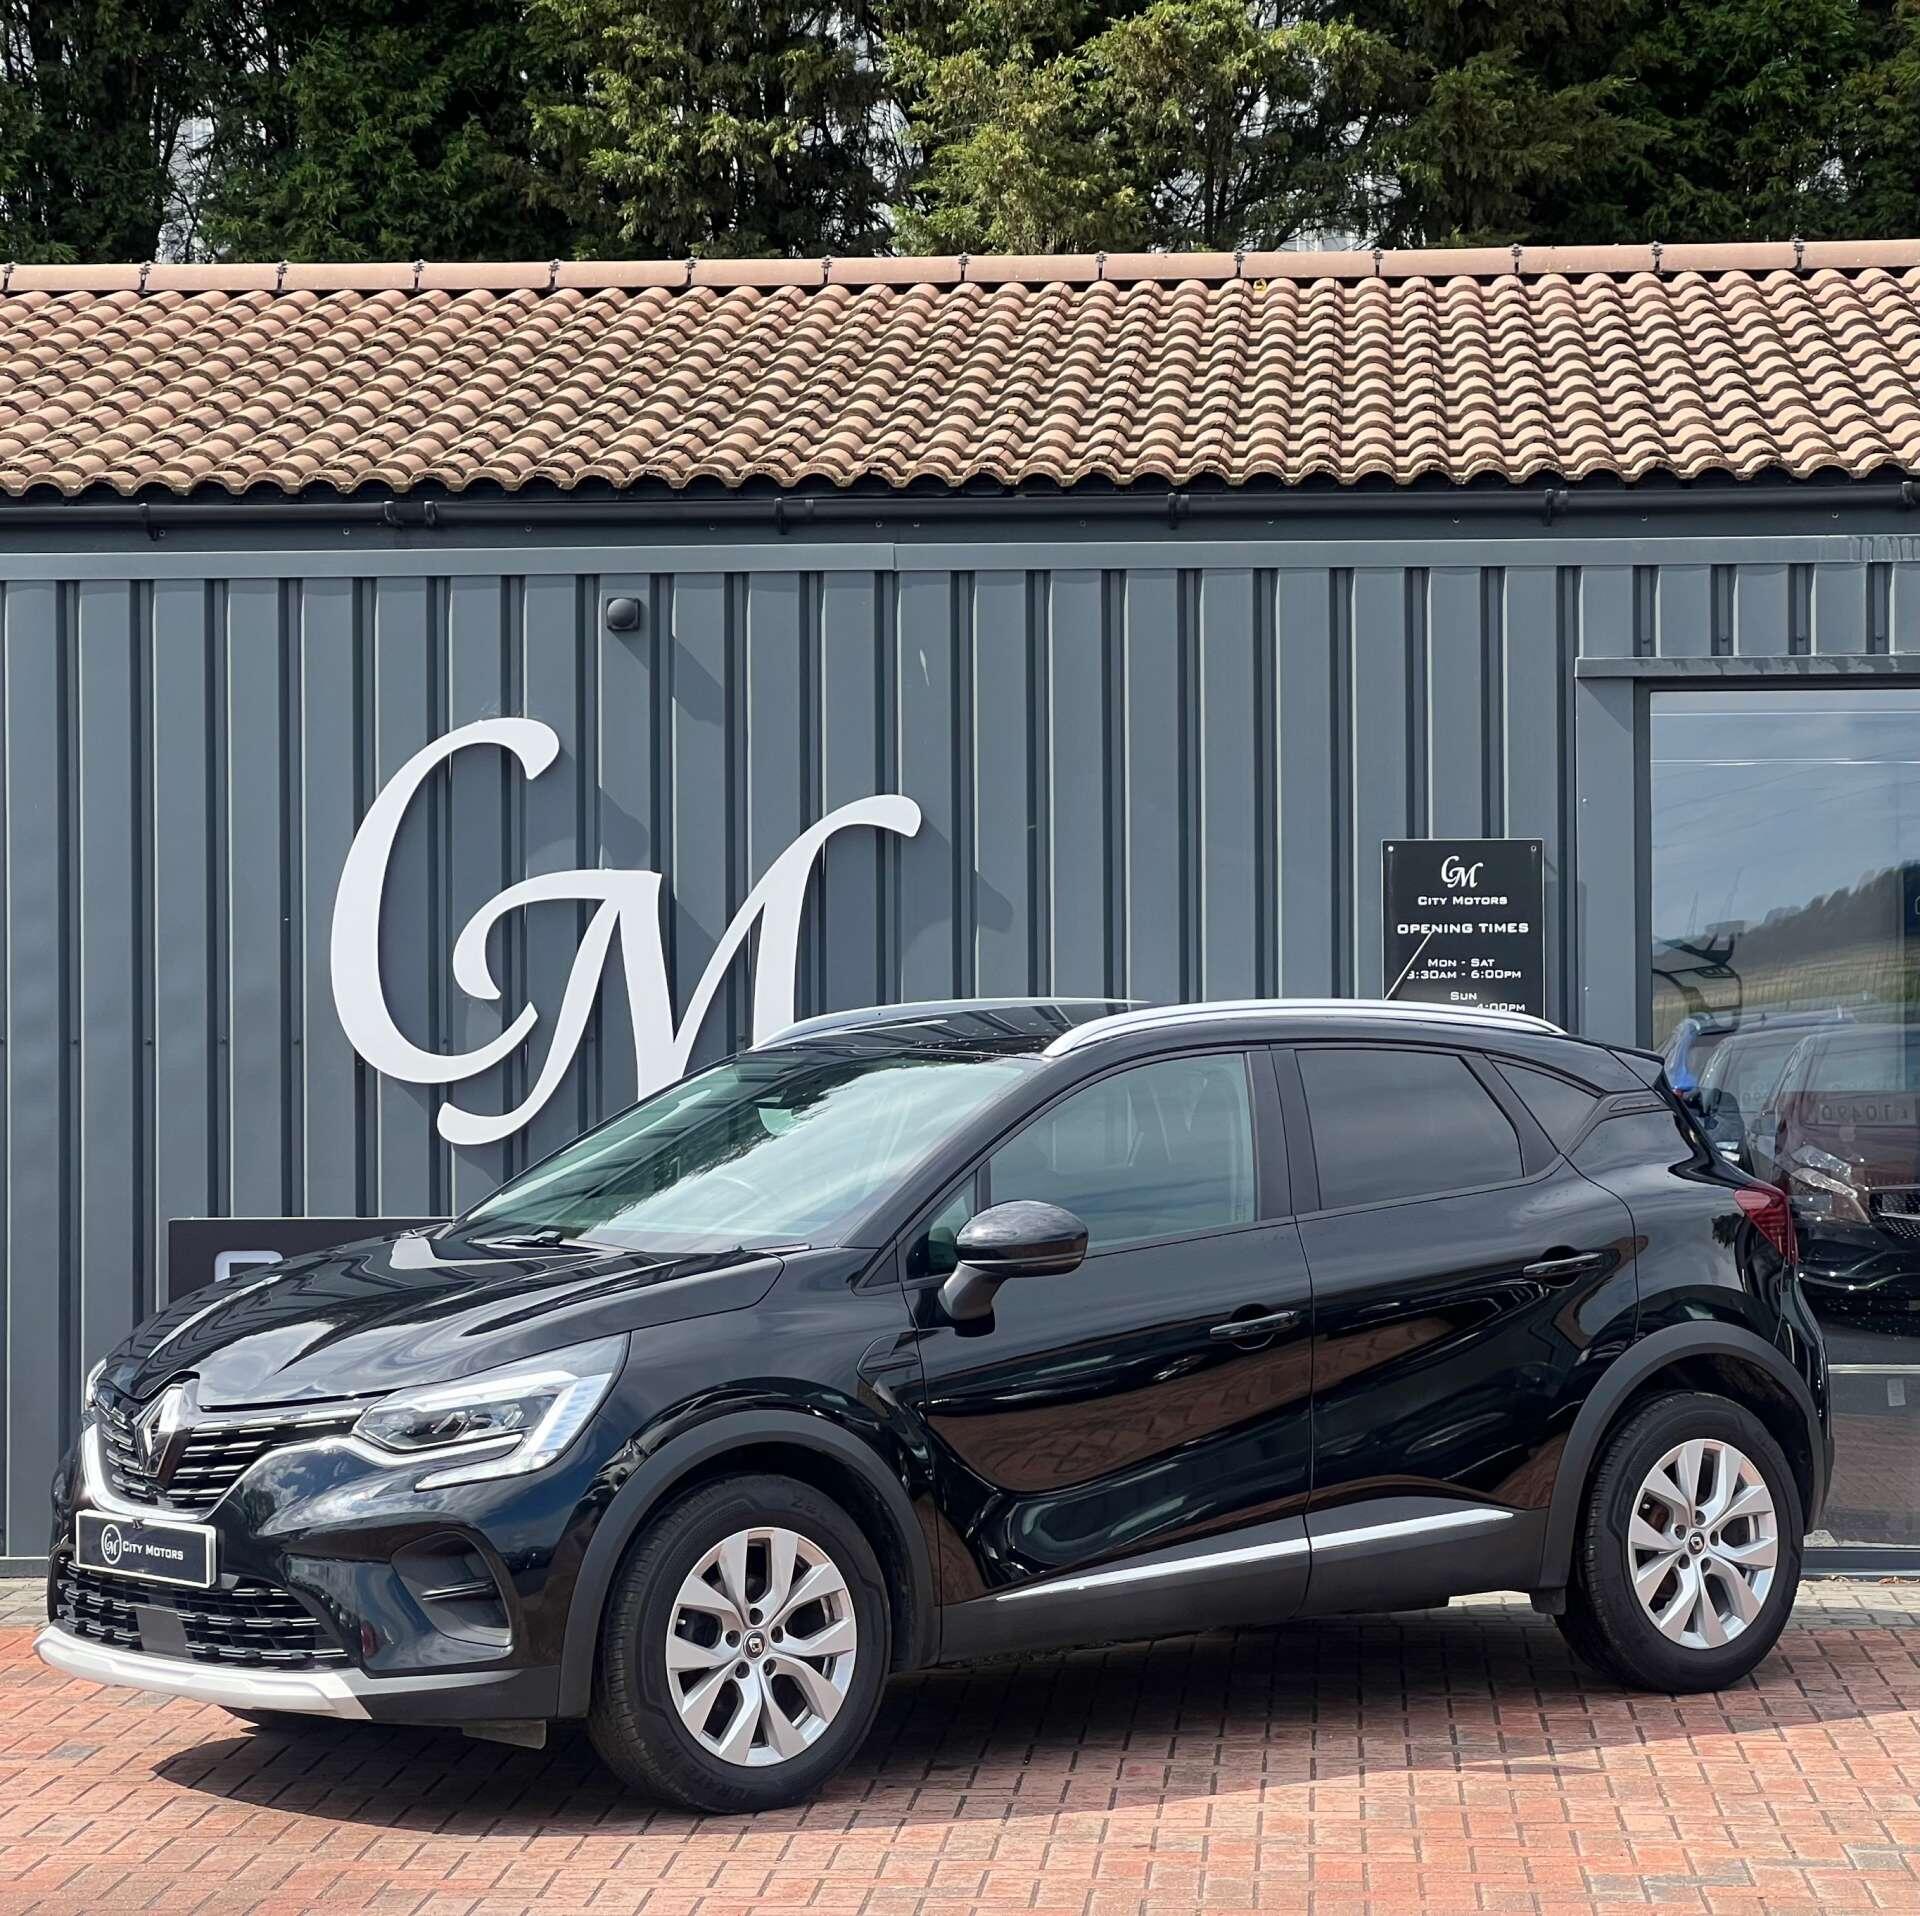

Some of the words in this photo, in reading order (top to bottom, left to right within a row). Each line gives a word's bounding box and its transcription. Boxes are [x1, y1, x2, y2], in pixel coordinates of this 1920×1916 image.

[1452, 896, 1508, 906] MOTORS
[1397, 923, 1474, 934] OPENING
[1479, 922, 1529, 934] TIMES
[1470, 969, 1522, 979] 6:00PM
[145, 1544, 184, 1561] MOTORS
